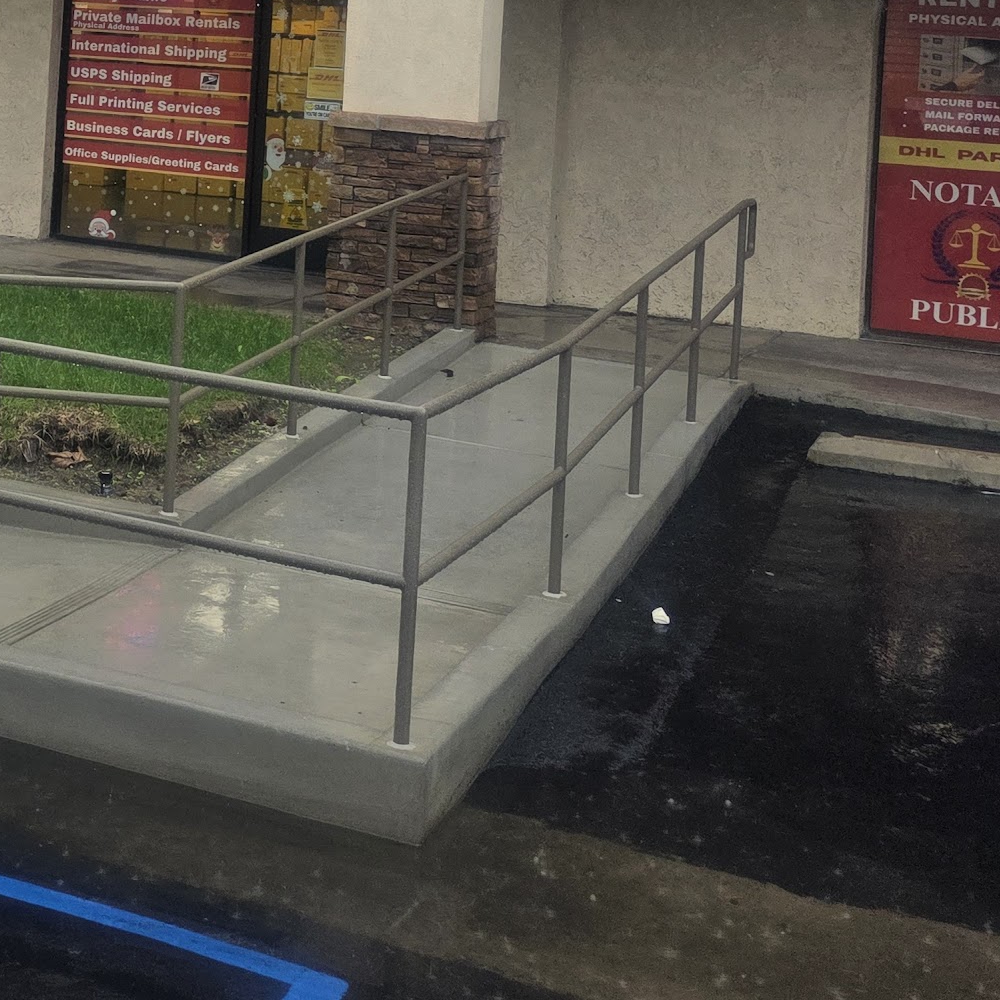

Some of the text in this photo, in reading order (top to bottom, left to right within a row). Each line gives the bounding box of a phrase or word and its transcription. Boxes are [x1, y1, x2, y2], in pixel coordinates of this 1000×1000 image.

[73, 9, 241, 30] Private Mailbox Rentals
[73, 20, 140, 32] Physical Address
[908, 13, 987, 27] PHYSICAL
[71, 39, 227, 62] International Shipping
[70, 66, 172, 87] USPS Shipping
[69, 93, 221, 116] Full Printing Services
[925, 97, 973, 108] SECURE
[925, 110, 954, 120] MAIL
[66, 119, 231, 145] Business Cards / Flyers
[924, 123, 980, 135] PACKAGE
[64, 147, 239, 173] Office Supplies/Greeting Cards
[899, 145, 945, 159] DHL
[909, 179, 1000, 208] NOTA
[909, 298, 1000, 330] PUBL
